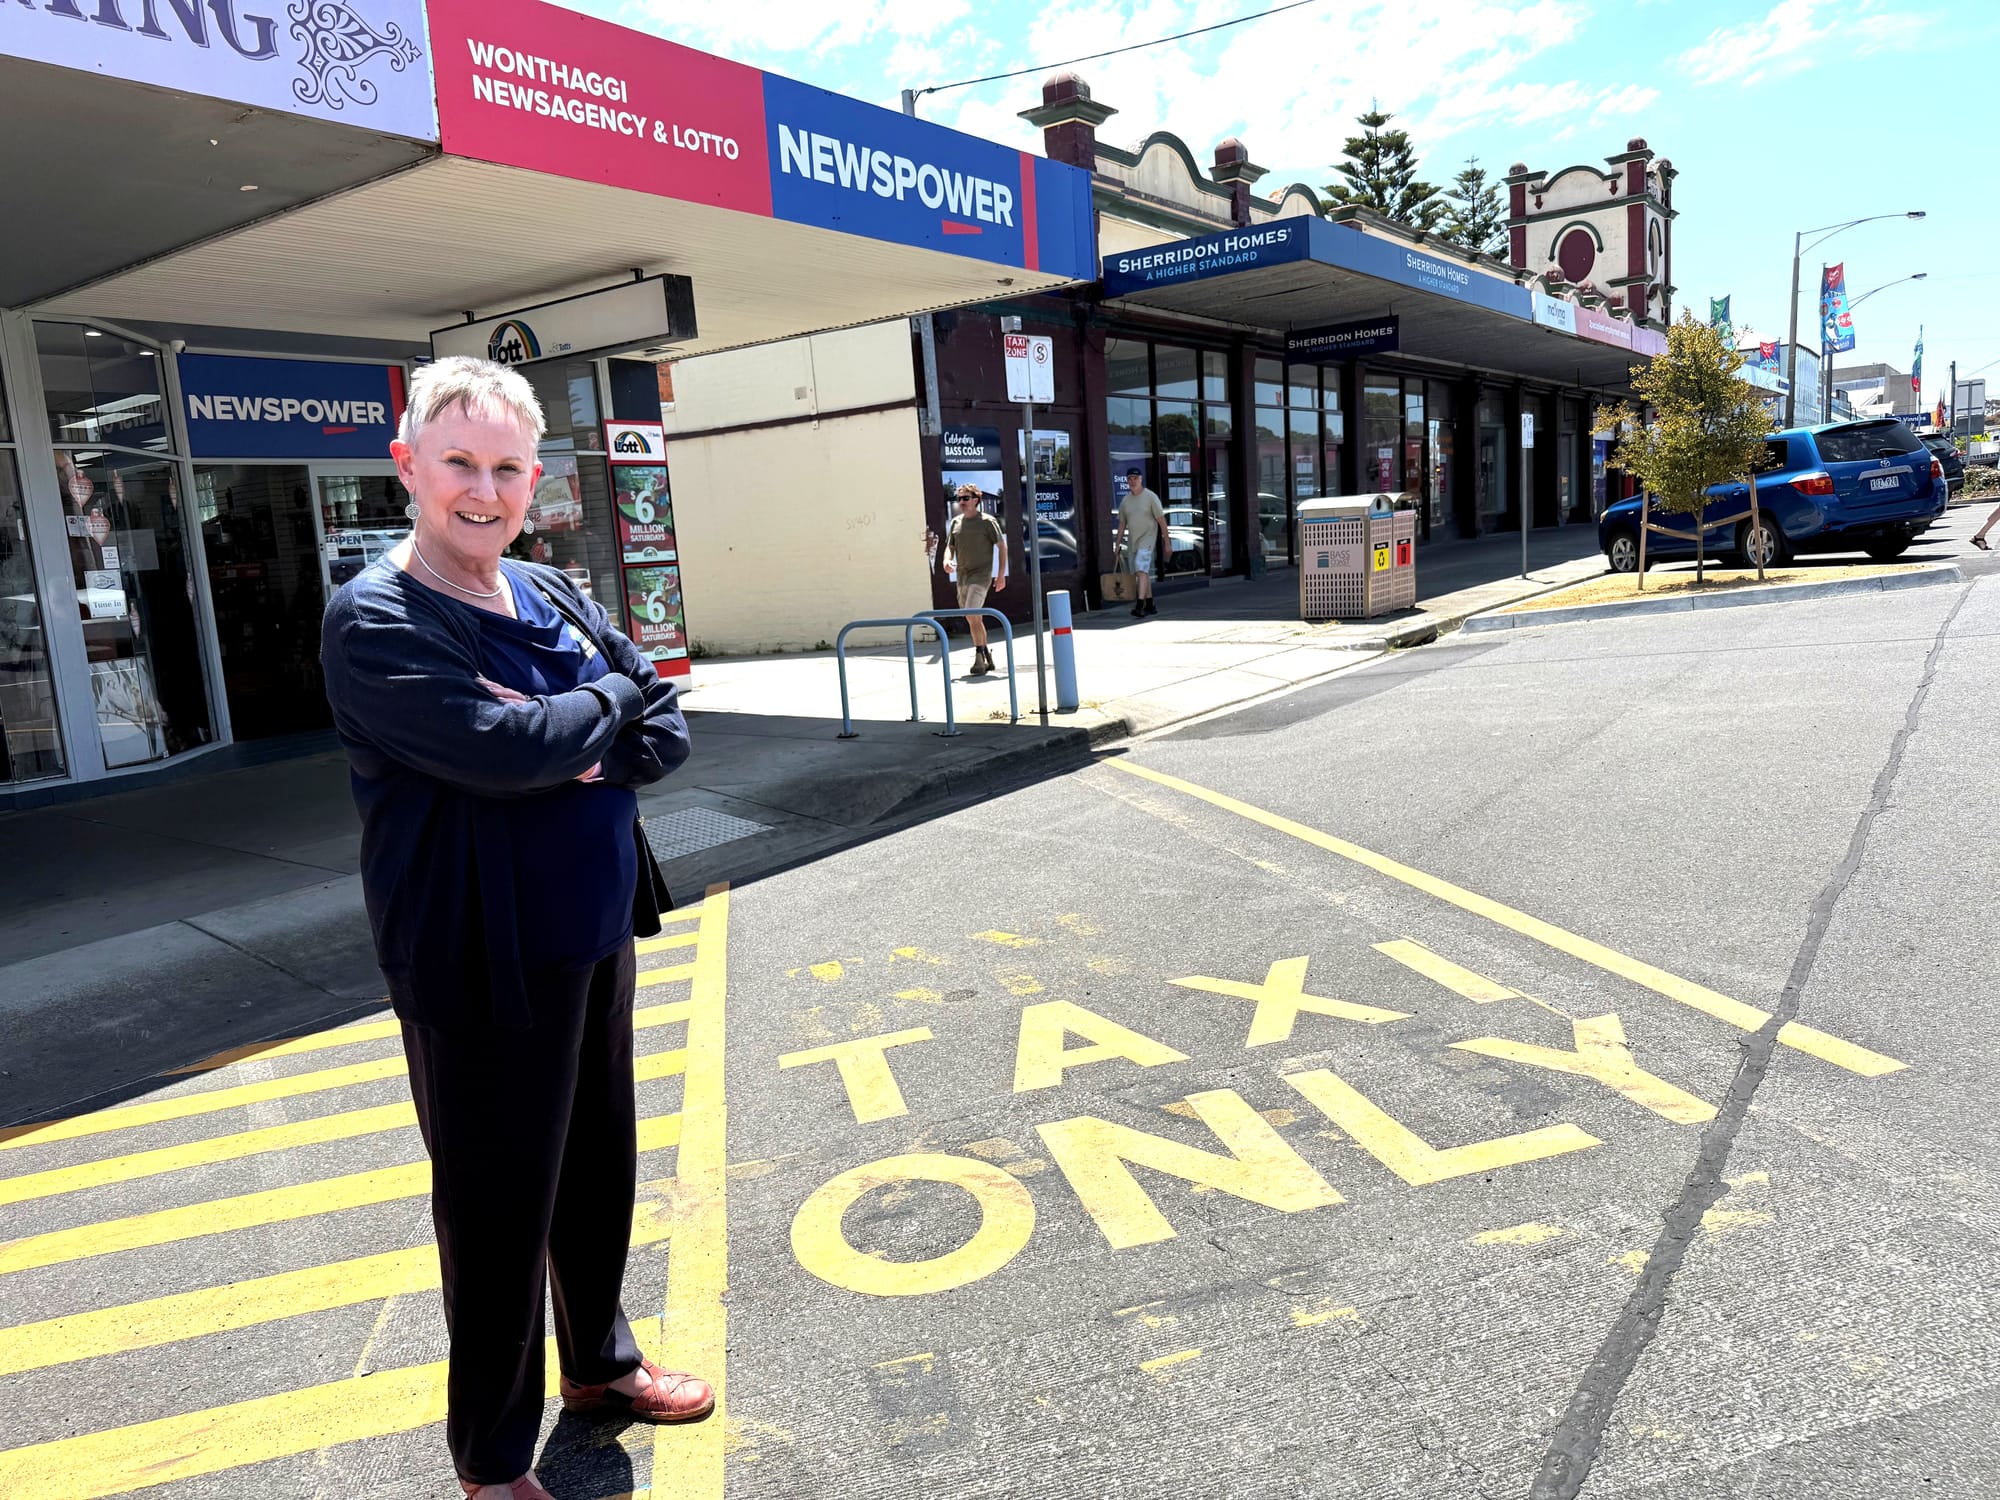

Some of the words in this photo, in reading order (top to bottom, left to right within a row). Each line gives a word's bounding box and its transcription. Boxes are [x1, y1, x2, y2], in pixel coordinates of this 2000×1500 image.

[466, 38, 628, 103] WONTHAGGI
[472, 74, 647, 138] NEWSAGENCY
[653, 120, 668, 145] &
[673, 124, 739, 160] LOTTO
[778, 123, 1014, 227] NEWSPOWER
[1119, 242, 1219, 273] SHERRIDON
[1146, 271, 1153, 281] A
[1156, 263, 1196, 279] HIGHER
[1199, 251, 1257, 271] STANDARD
[1406, 253, 1446, 278] SHERRIDON
[1007, 336, 1026, 347] TAXI
[1288, 332, 1352, 349] SHERRIDON
[1006, 347, 1027, 357] ZONE
[188, 394, 386, 424] NEWSPOWER
[614, 440, 640, 453] Lott
[945, 446, 961, 456] BASS
[962, 446, 984, 456] COAST
[1036, 511, 1048, 520] OME
[1049, 511, 1070, 520] BUILDER
[630, 533, 666, 542] SATURDAYS
[1330, 550, 1350, 559] BASS
[642, 633, 675, 642] SATURDAYS
[778, 939, 1522, 1124] TAXI
[790, 1012, 1720, 1297] ONLY
